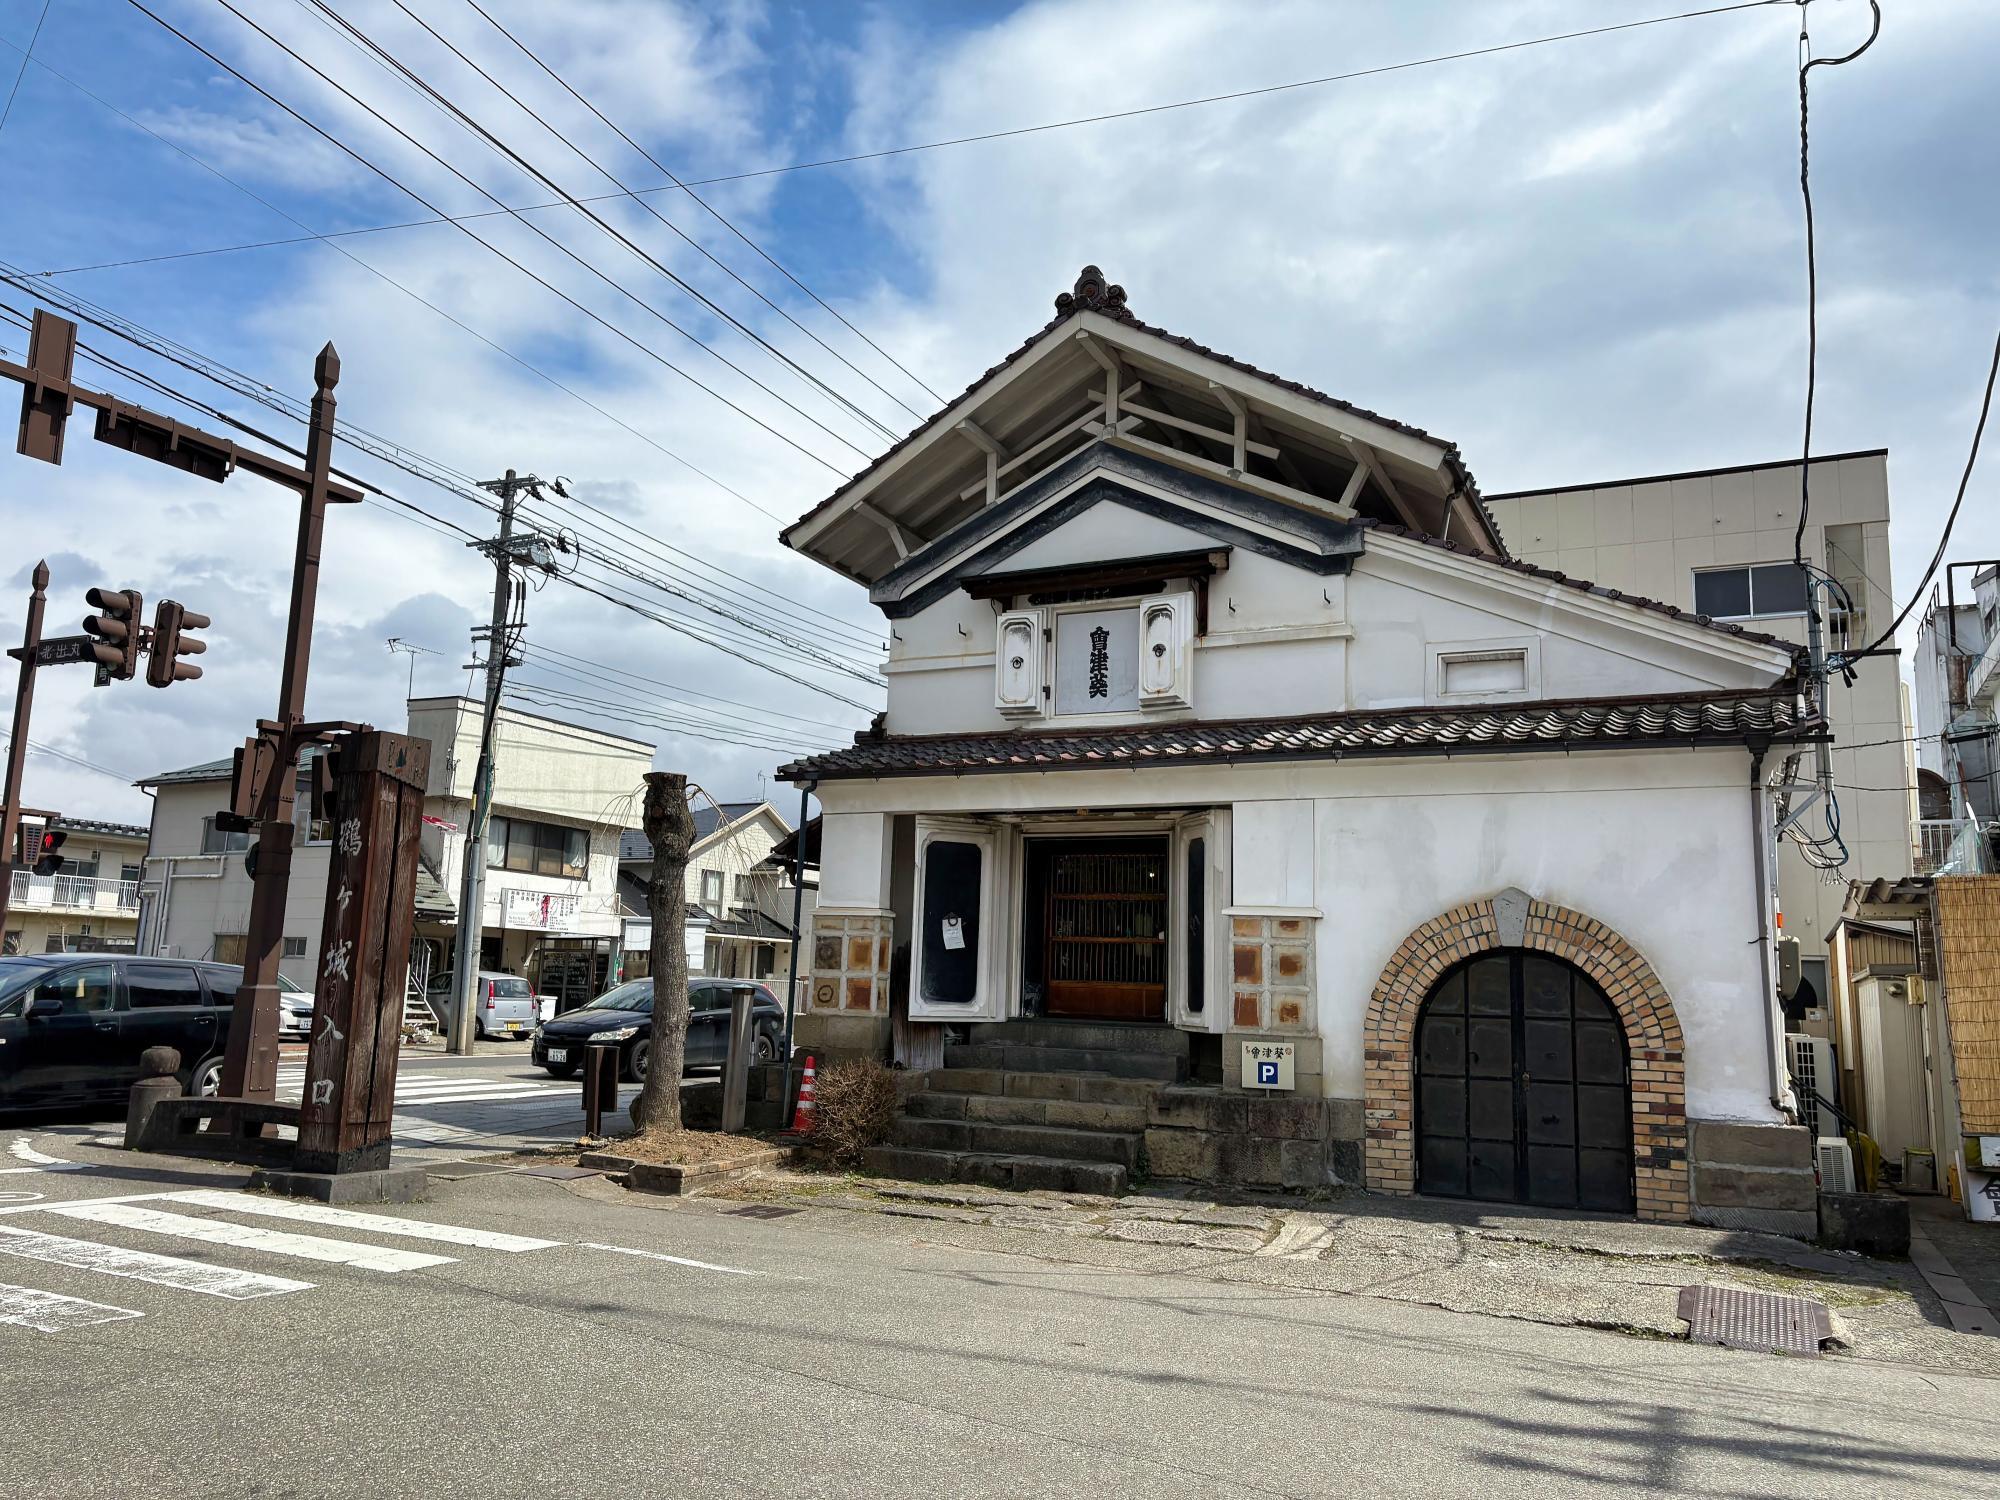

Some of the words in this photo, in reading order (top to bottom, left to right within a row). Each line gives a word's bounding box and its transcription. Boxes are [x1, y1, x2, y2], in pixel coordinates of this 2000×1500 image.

[1089, 625, 1110, 700] 會津葵
[1250, 1046, 1285, 1060] 會津葵
[1262, 1065, 1275, 1082] P
